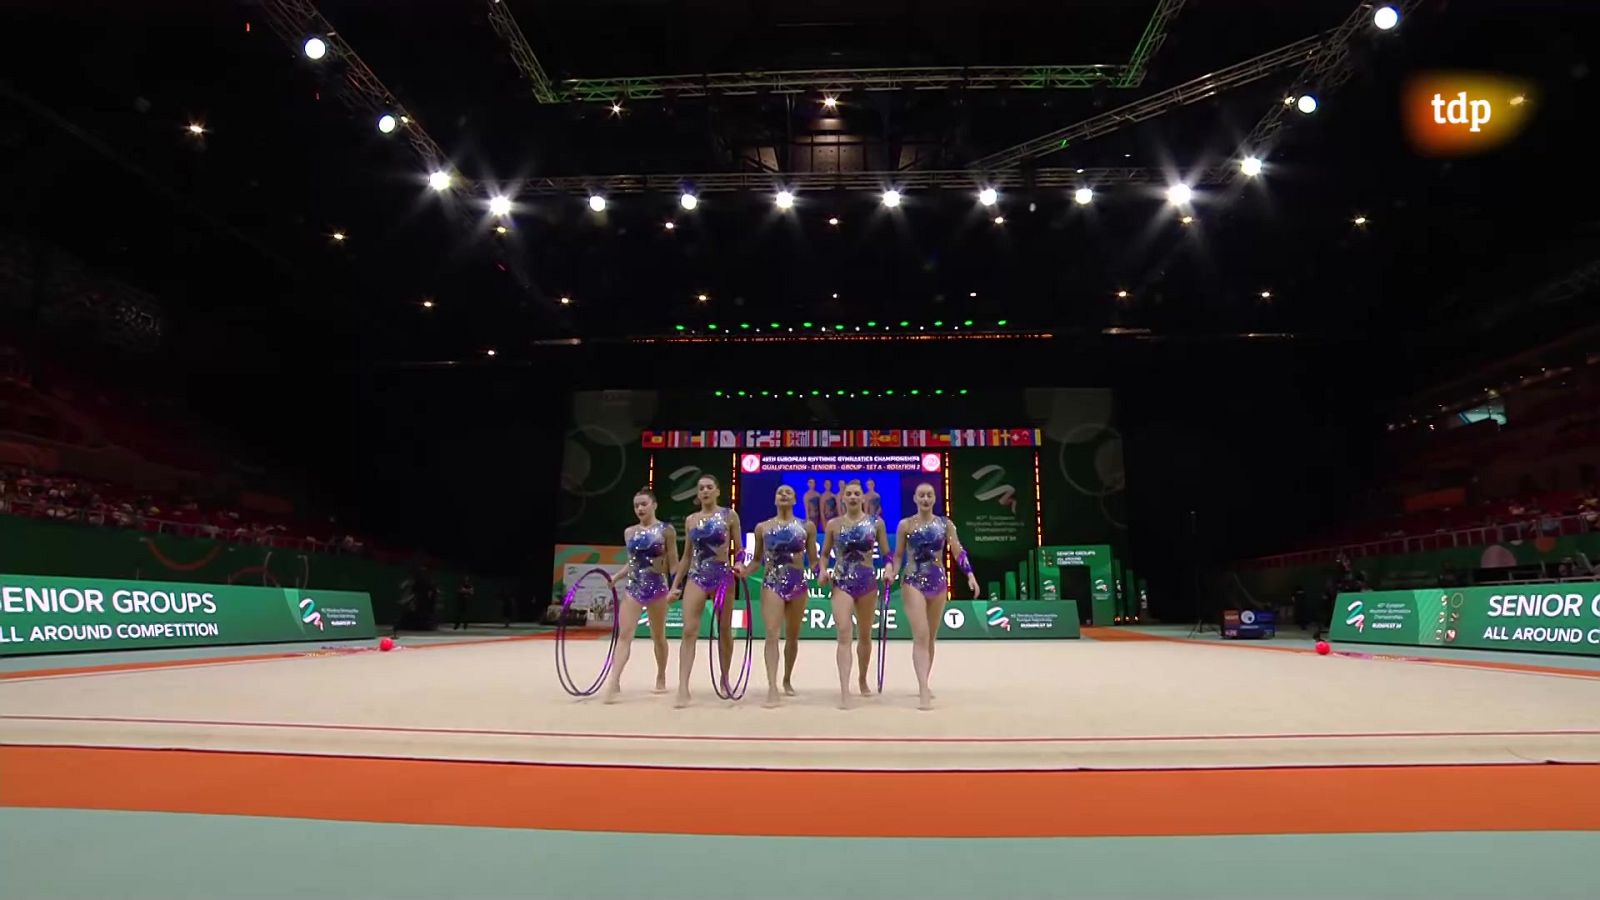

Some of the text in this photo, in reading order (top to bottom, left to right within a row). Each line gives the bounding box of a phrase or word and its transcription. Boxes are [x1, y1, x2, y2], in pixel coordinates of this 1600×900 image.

[0, 587, 217, 614] ENIOR GROUPS
[1487, 594, 1583, 617] SENIOR
[29, 624, 112, 642] AROUND
[116, 623, 219, 639] COMPETITION
[1483, 626, 1509, 640] ALL
[1512, 627, 1583, 643] AROUND
